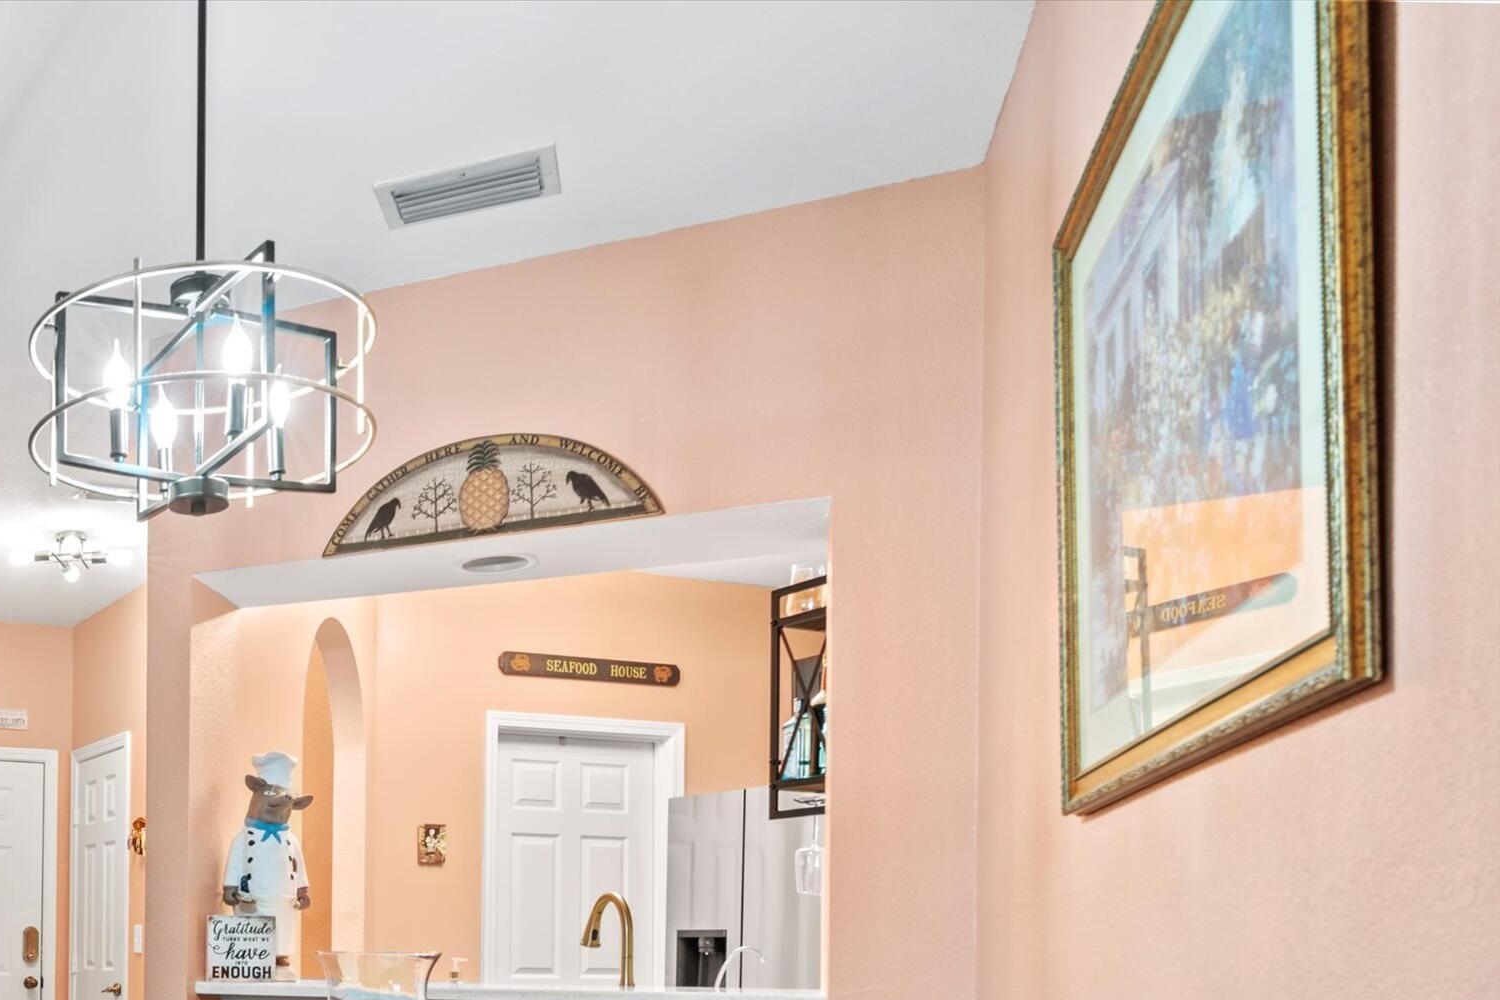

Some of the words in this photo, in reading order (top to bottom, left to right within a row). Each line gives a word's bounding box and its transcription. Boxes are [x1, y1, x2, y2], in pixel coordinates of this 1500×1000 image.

[331, 510, 359, 547] COME
[365, 464, 410, 502] GATHER
[424, 442, 462, 465] HERE
[508, 433, 541, 447] AND
[559, 438, 626, 478] WELCOME
[546, 659, 598, 676] SEAFOOD
[610, 664, 648, 679] HOUSE
[213, 920, 276, 941] Gratitude
[215, 942, 271, 960] have
[212, 966, 272, 979] ENOUGH
